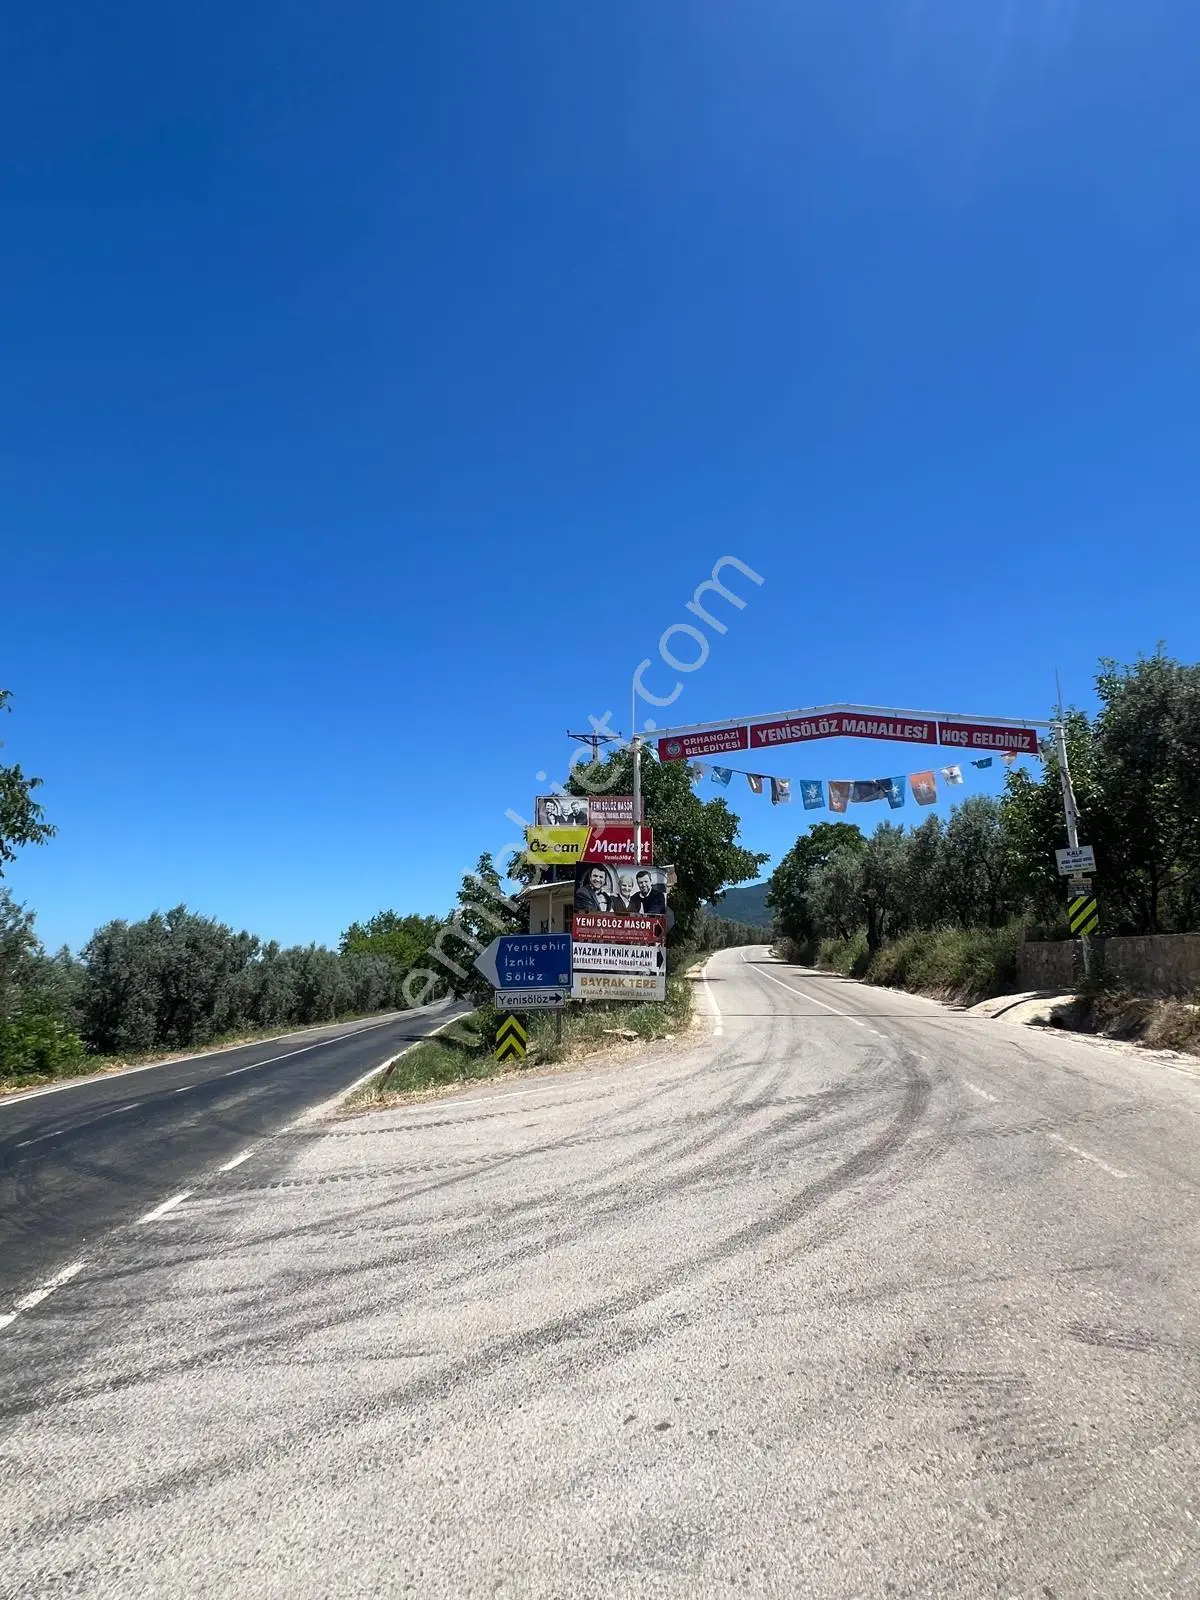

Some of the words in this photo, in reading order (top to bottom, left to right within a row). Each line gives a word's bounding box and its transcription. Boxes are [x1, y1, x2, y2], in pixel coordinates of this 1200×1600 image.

[757, 719, 839, 742] YENİSÖLÖZ
[842, 719, 928, 740] MAHALLESİ
[683, 730, 739, 746] ORHANGAZİ
[942, 729, 968, 746] HOŞ
[973, 732, 1030, 749] GELDİNİZ
[685, 740, 740, 755] BELEDİYESİ
[576, 917, 595, 926] YENİ
[506, 941, 566, 952] Yenişehir
[574, 946, 602, 956] AYAZMA
[604, 947, 628, 958] PİKNİK
[631, 950, 652, 959] ALANI
[505, 955, 535, 966] İznik
[581, 977, 625, 988] BAYRAK
[499, 993, 548, 1005] Yenisölöz
